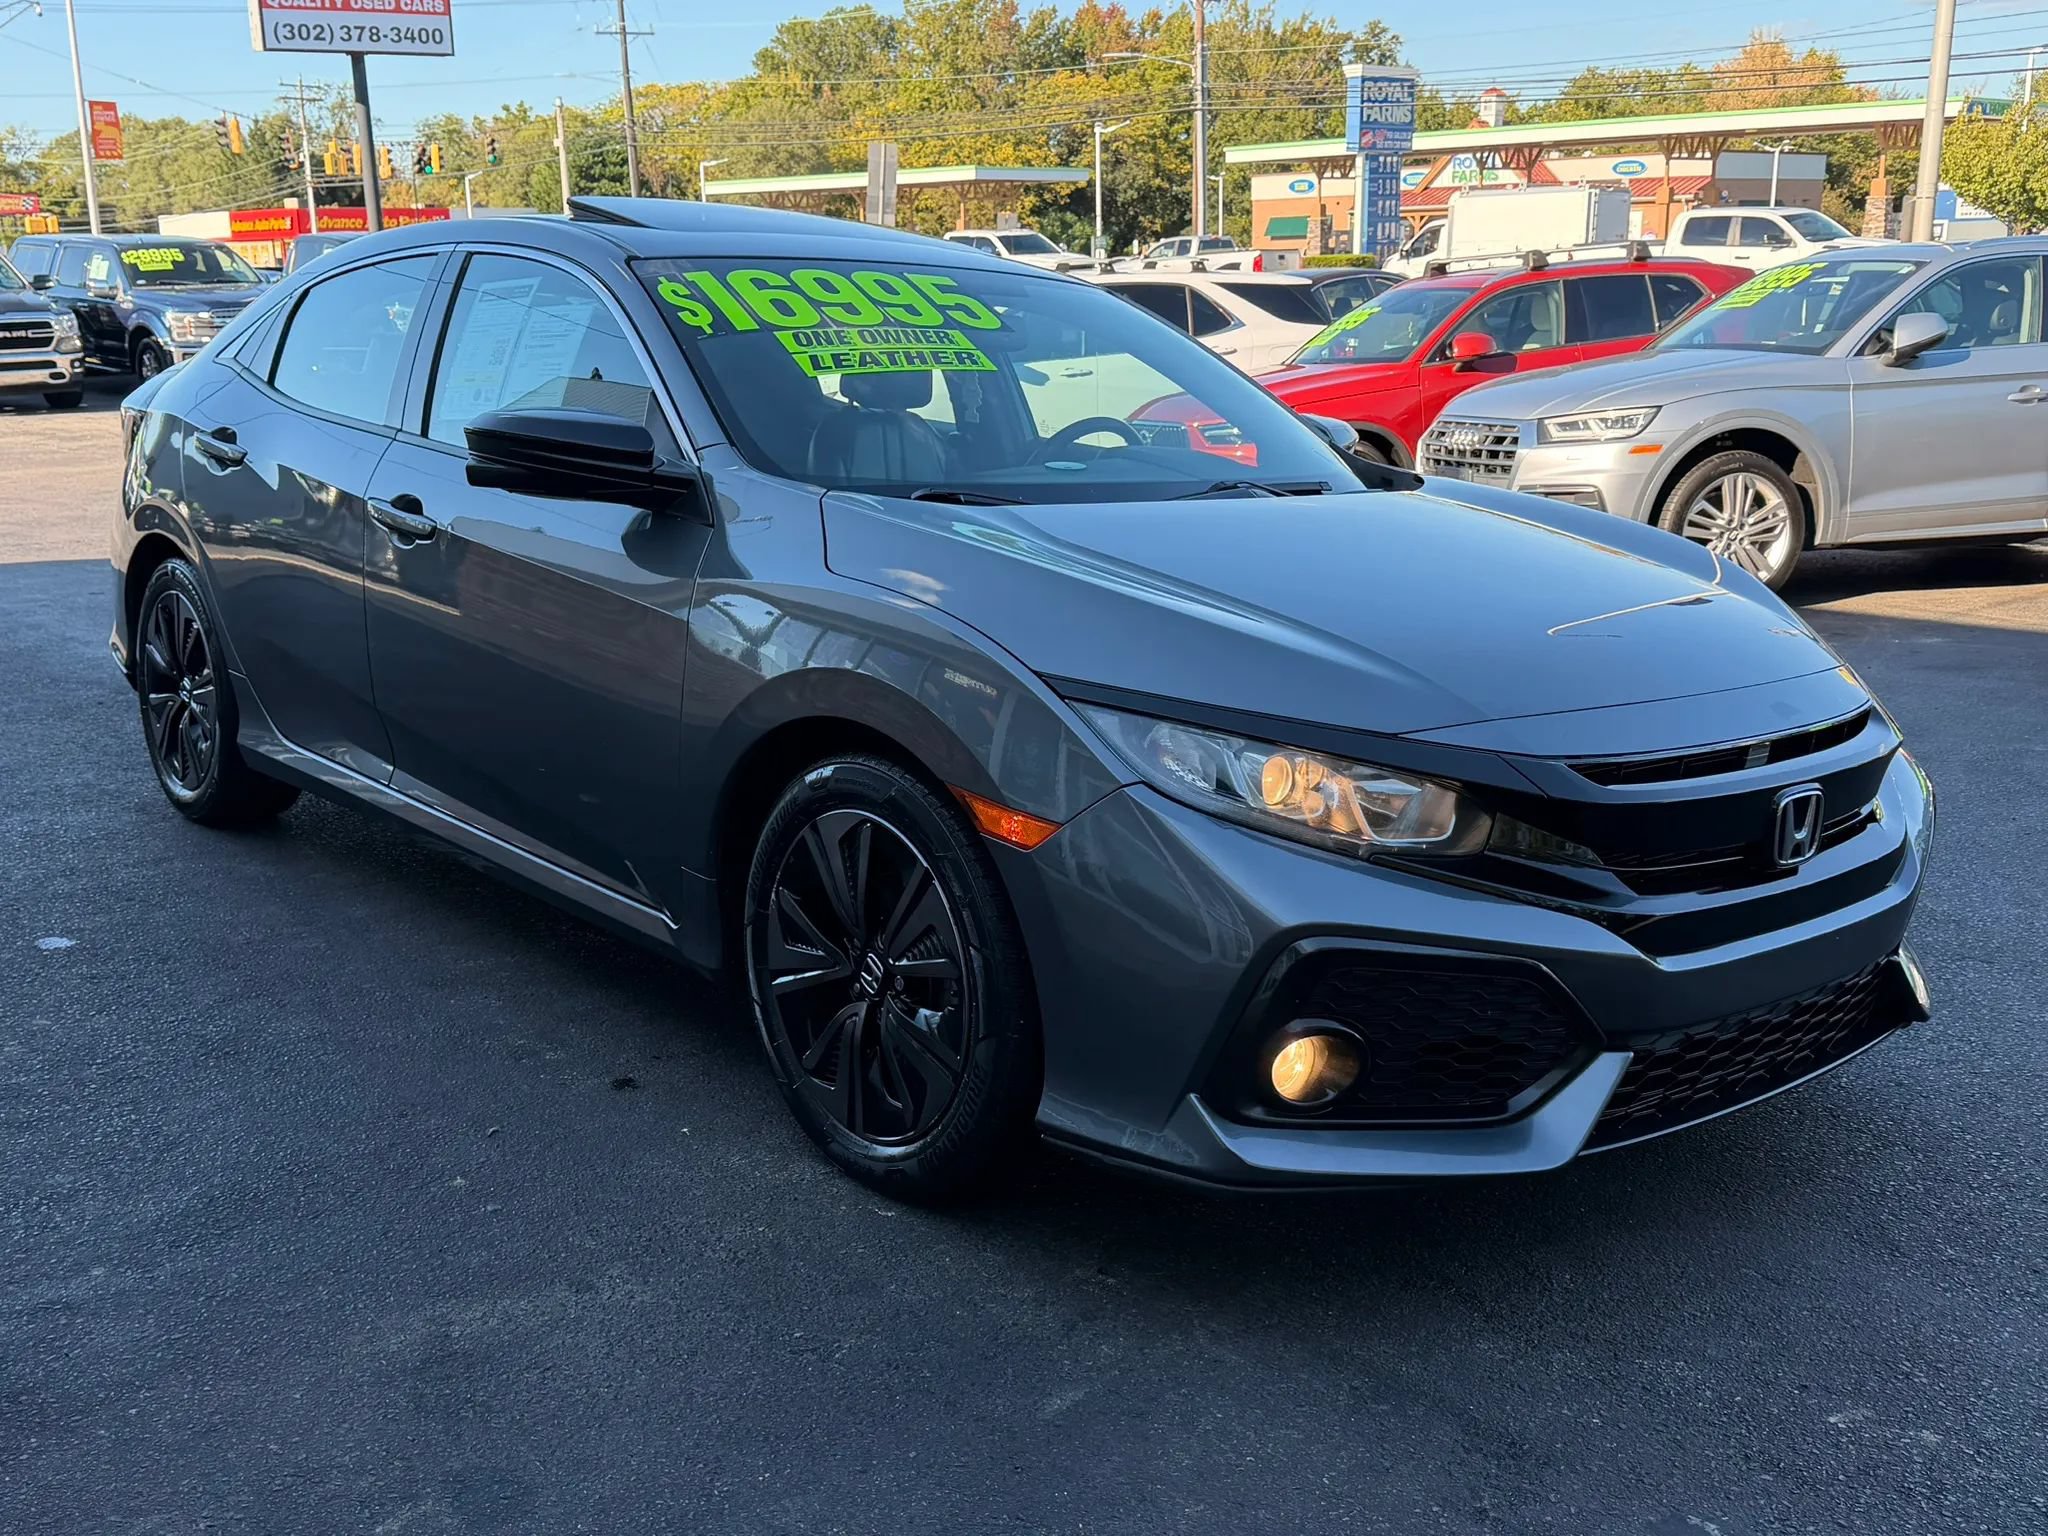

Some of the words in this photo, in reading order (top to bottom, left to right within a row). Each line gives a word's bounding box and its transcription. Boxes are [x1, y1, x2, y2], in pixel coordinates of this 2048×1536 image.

[350, 0, 396, 10] USED
[400, 0, 445, 13] CARS
[273, 22, 335, 45] (302)
[339, 25, 444, 45] 378-3400
[1363, 81, 1412, 101] ROYAL
[1363, 102, 1412, 123] FARMS
[657, 268, 1002, 336] $16995
[790, 330, 850, 347] ONE
[858, 329, 958, 347] OWNER
[811, 350, 981, 372] LEATHER
